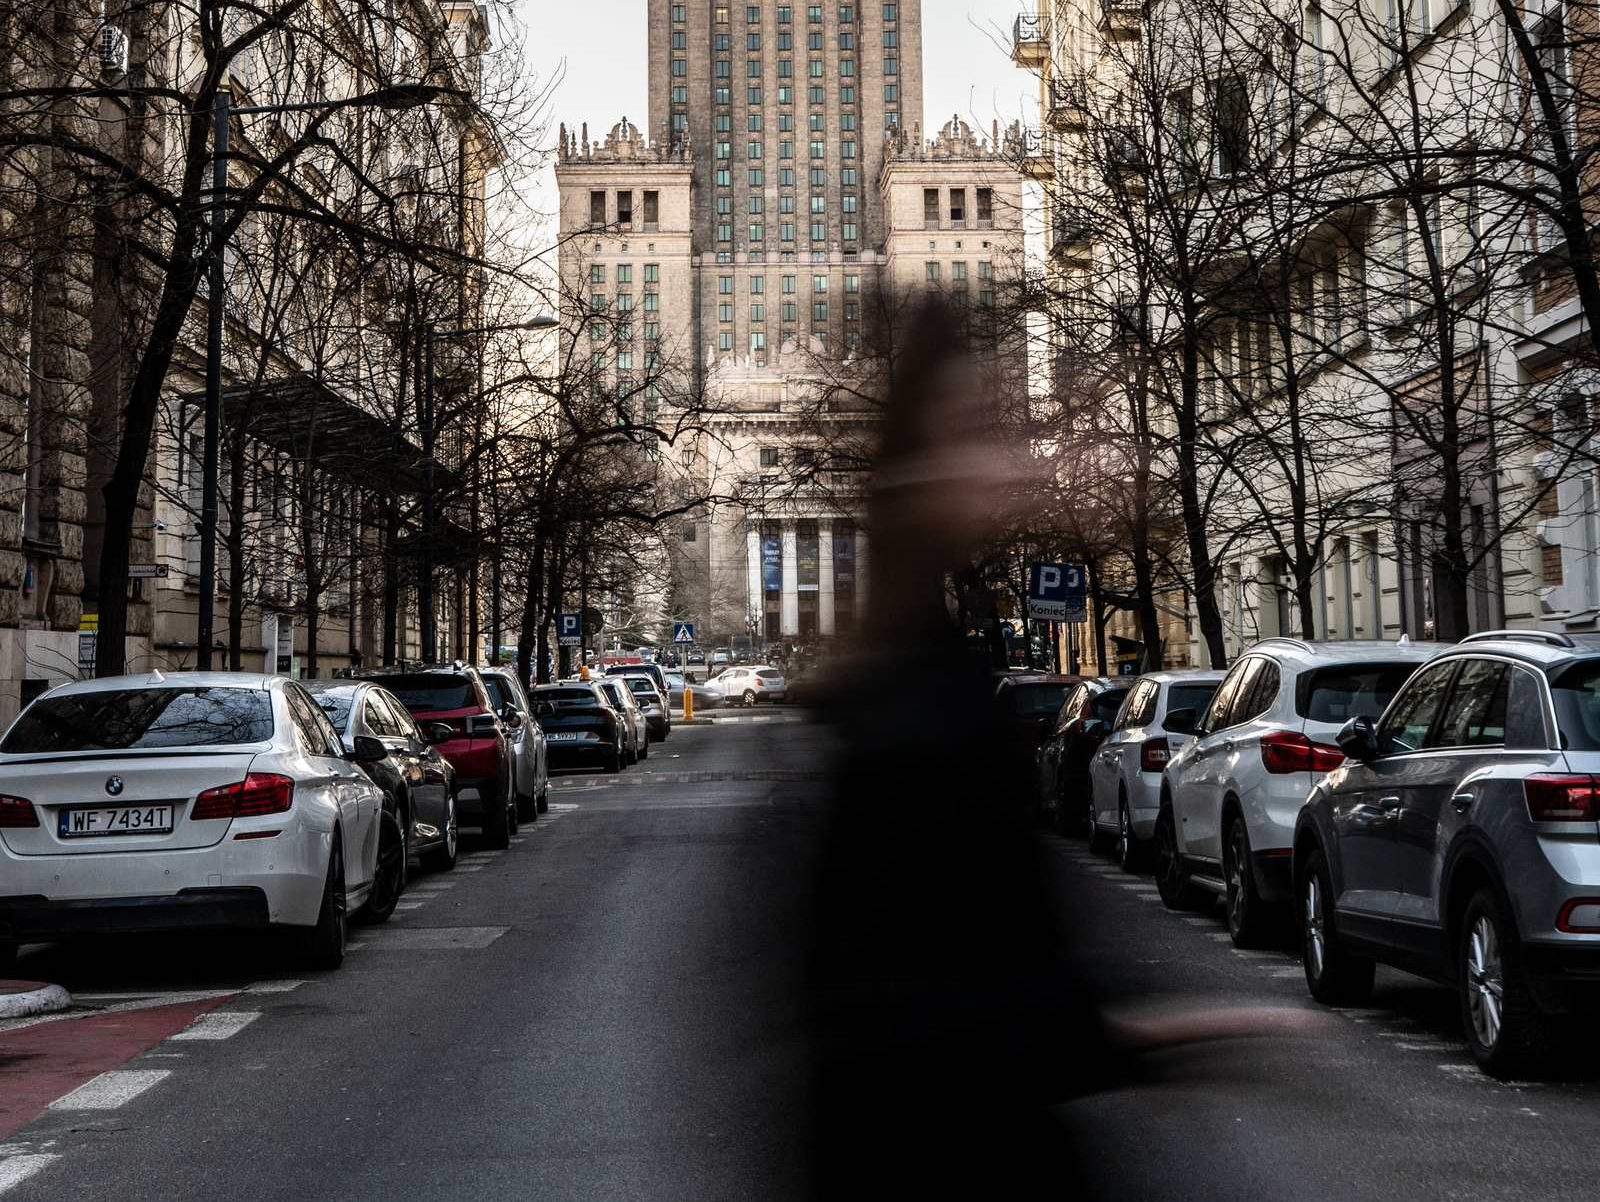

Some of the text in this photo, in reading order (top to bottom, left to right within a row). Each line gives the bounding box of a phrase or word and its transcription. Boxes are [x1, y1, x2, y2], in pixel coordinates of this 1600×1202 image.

[1039, 566, 1061, 595] P
[1030, 604, 1065, 616] Koniec
[564, 616, 576, 634] P
[1124, 664, 1132, 674] P
[74, 808, 167, 831] WF 7434T
